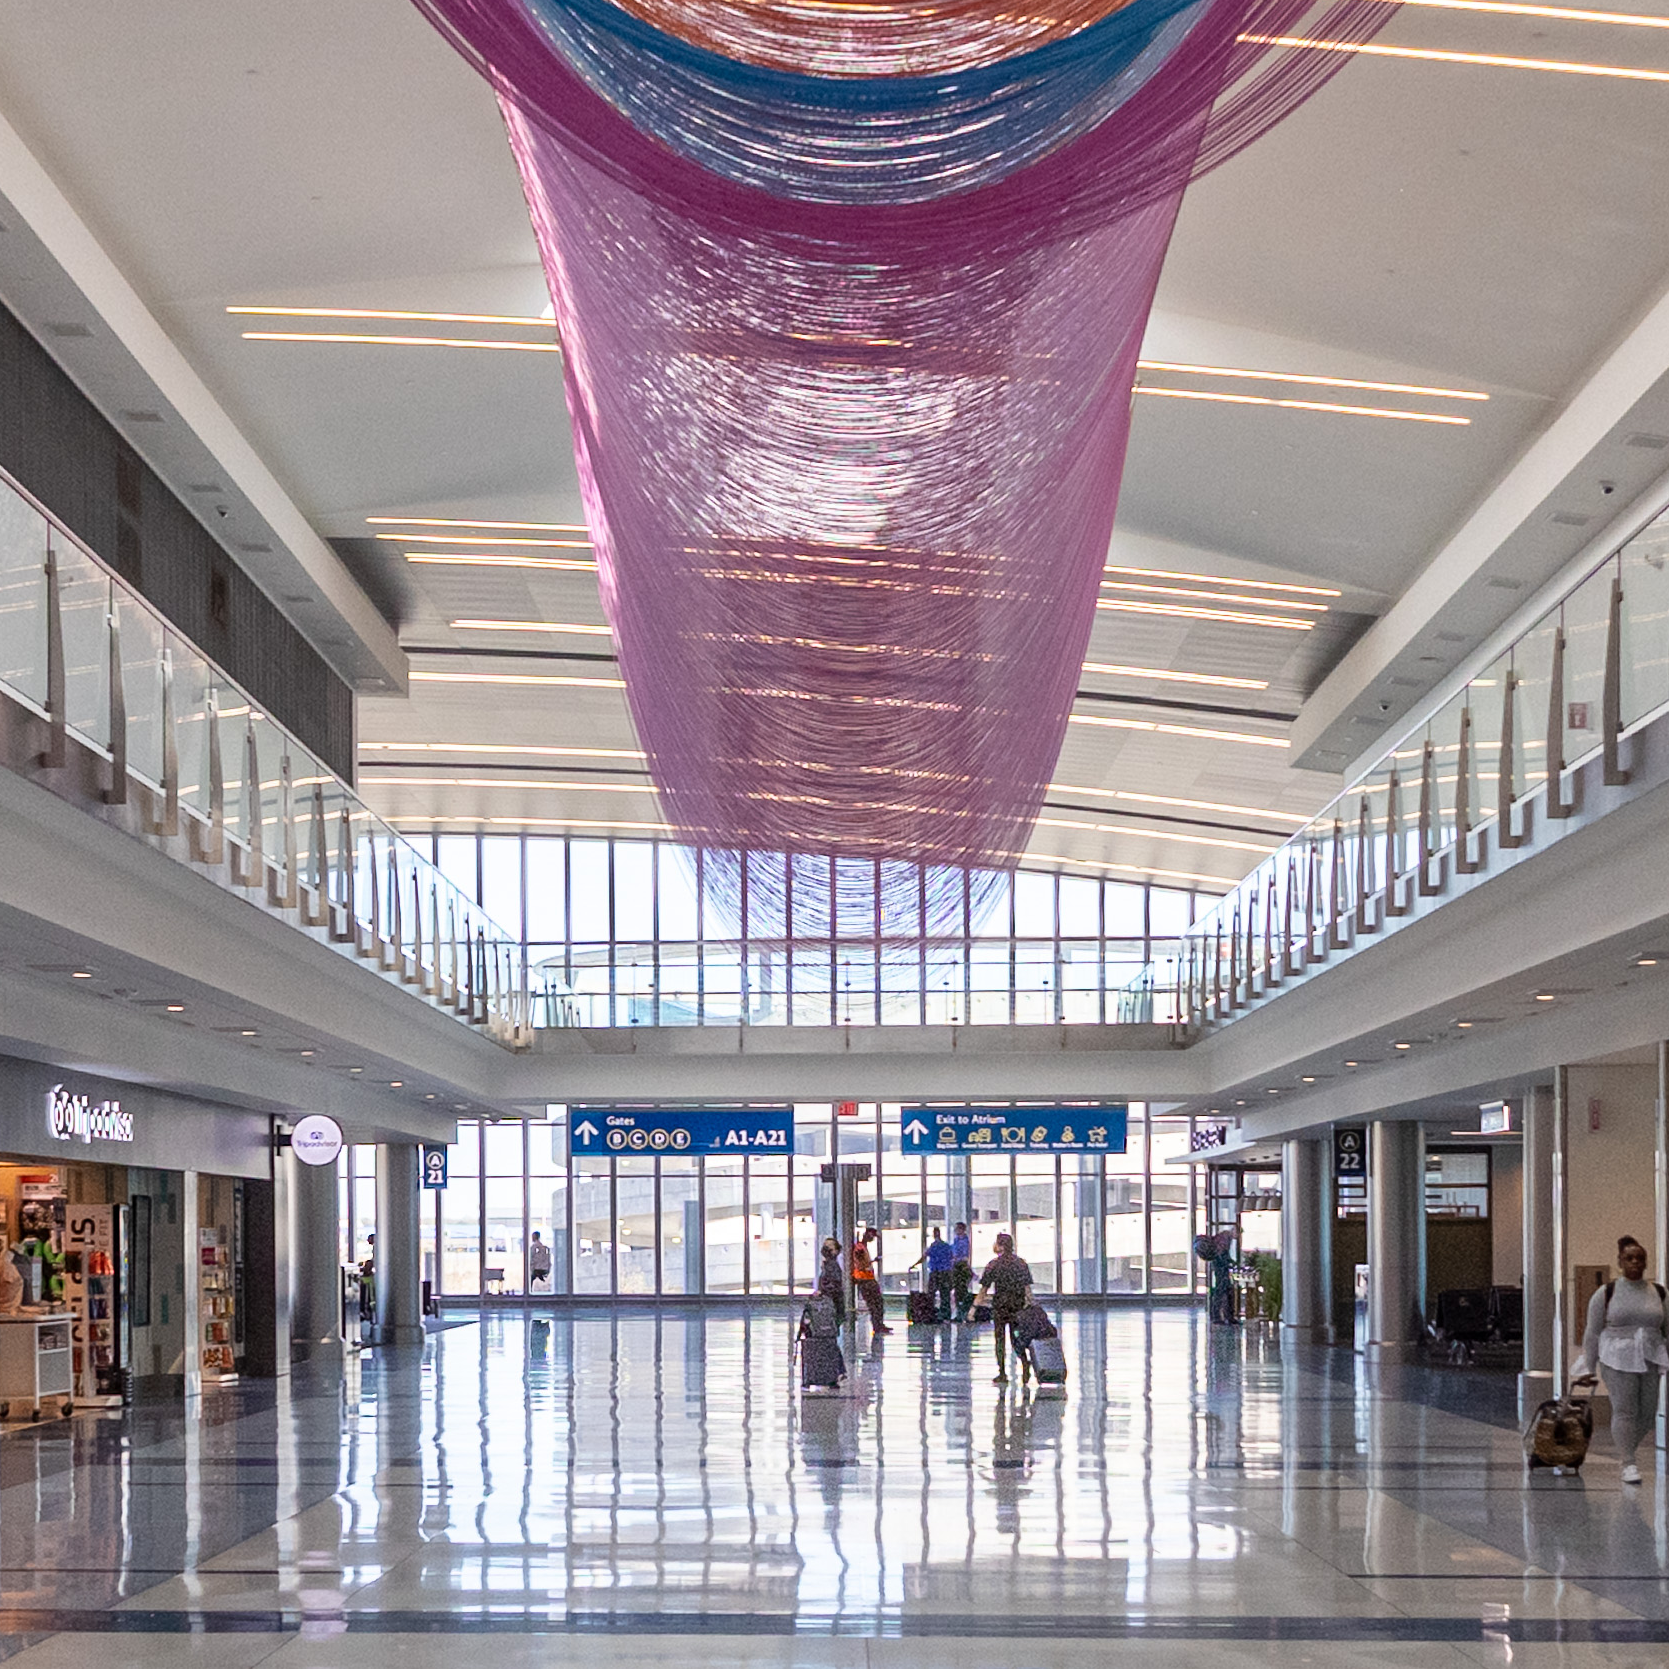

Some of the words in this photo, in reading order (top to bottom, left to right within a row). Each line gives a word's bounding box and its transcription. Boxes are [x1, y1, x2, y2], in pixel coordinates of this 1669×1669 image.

[606, 1116, 635, 1126] Gates
[936, 1114, 956, 1125] Exit
[958, 1116, 969, 1125] to
[972, 1114, 1006, 1125] Atrium
[612, 1133, 622, 1144] B
[632, 1133, 643, 1144] C
[654, 1133, 665, 1144] D
[676, 1133, 685, 1144] E
[724, 1129, 787, 1146] A1-A21
[1344, 1135, 1356, 1148] A
[431, 1155, 441, 1166] A
[1340, 1153, 1360, 1169] 22
[427, 1169, 444, 1184] 21
